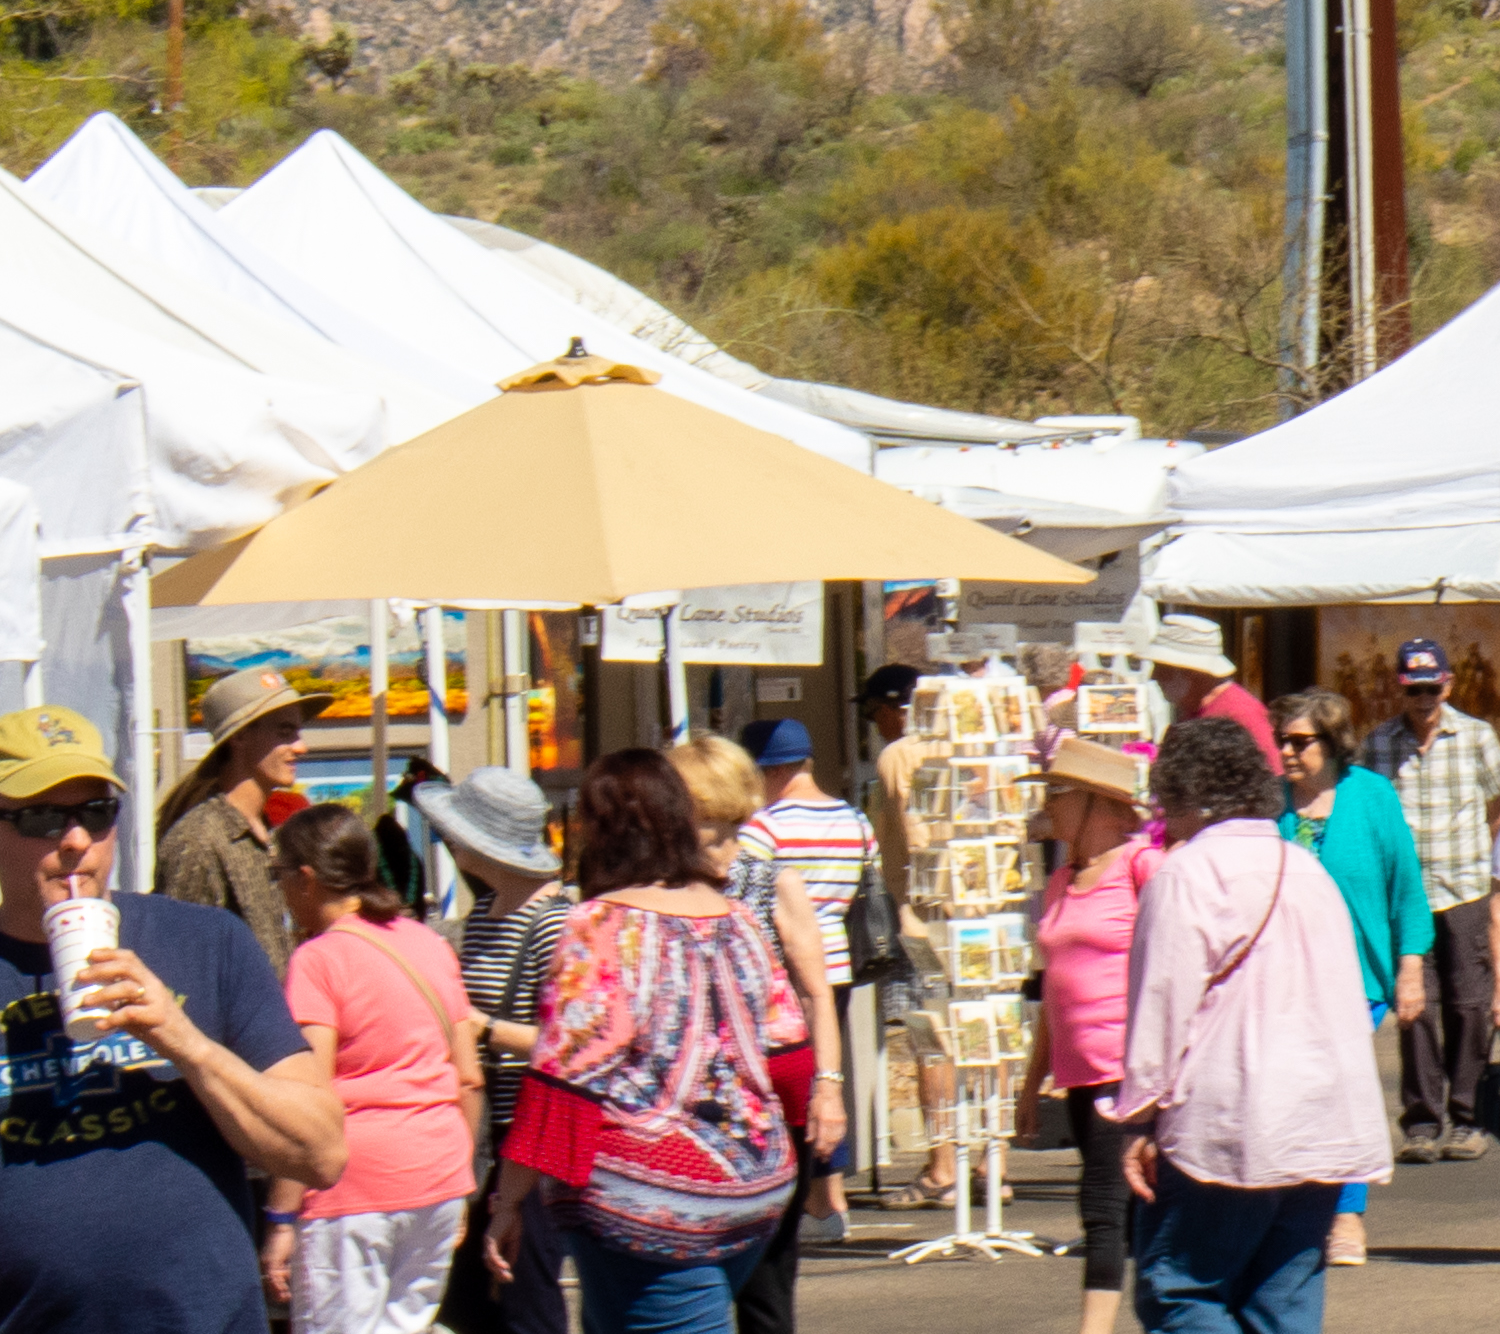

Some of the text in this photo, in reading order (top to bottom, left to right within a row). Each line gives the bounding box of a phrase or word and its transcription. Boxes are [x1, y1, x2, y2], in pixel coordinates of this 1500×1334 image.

[679, 603, 725, 623] Lane
[728, 603, 804, 624] Studios
[0, 1040, 158, 1086] CHEVROLE
[0, 1087, 177, 1146] CLASSIC
